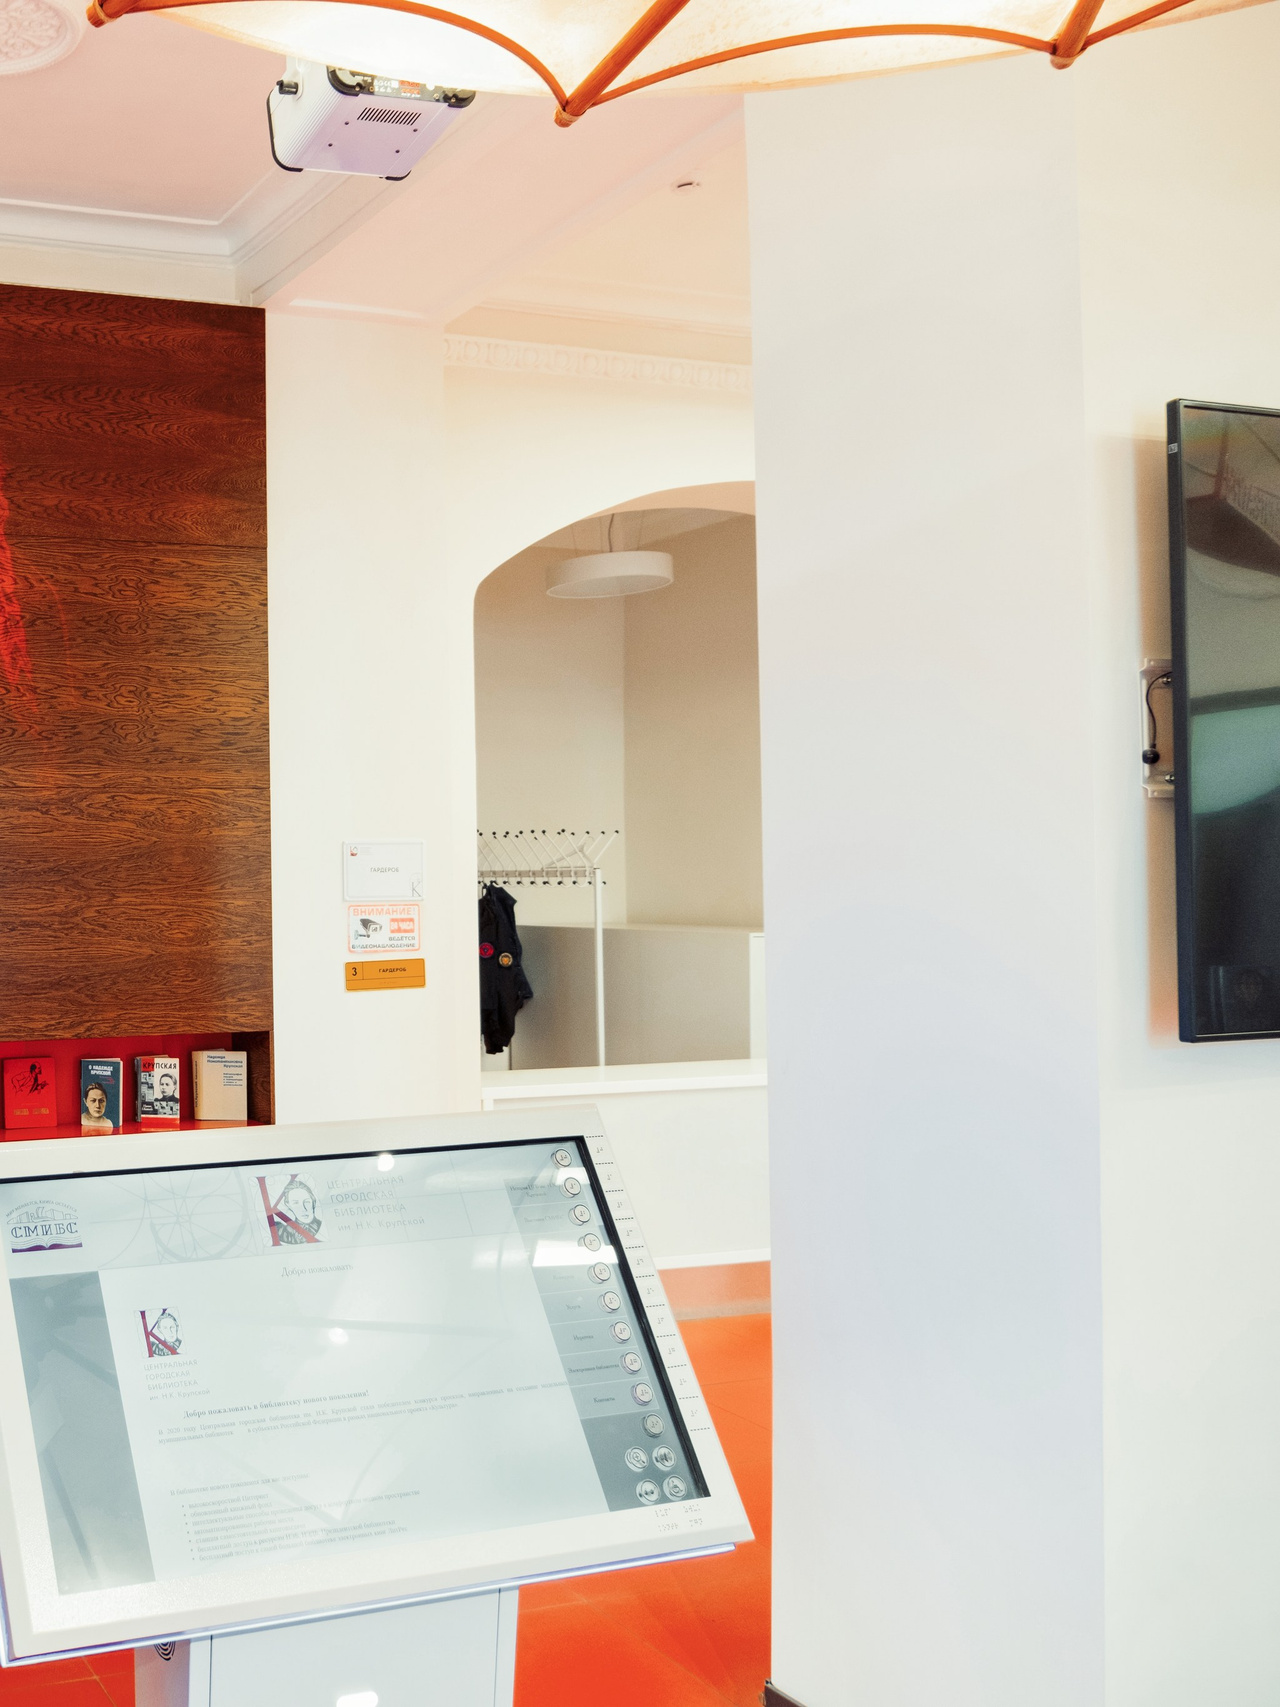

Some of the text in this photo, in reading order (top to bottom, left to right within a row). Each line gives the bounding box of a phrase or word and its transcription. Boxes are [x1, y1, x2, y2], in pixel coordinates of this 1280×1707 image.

[352, 967, 358, 976] 3
[326, 1175, 404, 1190] ЦЕНТРАЛЬНАЯ
[330, 1190, 395, 1203] ГОРОДСКАЯ
[334, 1203, 407, 1217] БИБЛИОТЕКА
[378, 1216, 425, 1229] Крупской
[11, 1222, 78, 1238] СМИБС
[281, 1264, 354, 1277] Добро пожаловать
[144, 1359, 198, 1371] ЦЕНТРАЛЬНАЯ
[146, 1370, 190, 1380] ГОРОДСКАЯ
[148, 1379, 199, 1390] БИБЛИОТЕКА
[178, 1388, 210, 1398] Крупской
[183, 1410, 206, 1419] Добро
[208, 1406, 252, 1415] пожаловать
[260, 1400, 301, 1409] библиотеку
[303, 1395, 327, 1404] нового
[329, 1390, 370, 1400] поколения!
[200, 1421, 236, 1430] Центральная
[239, 1418, 266, 1426] городская
[269, 1413, 300, 1422] библиотека
[331, 1406, 357, 1415] Крупской
[230, 1480, 259, 1488] поколения
